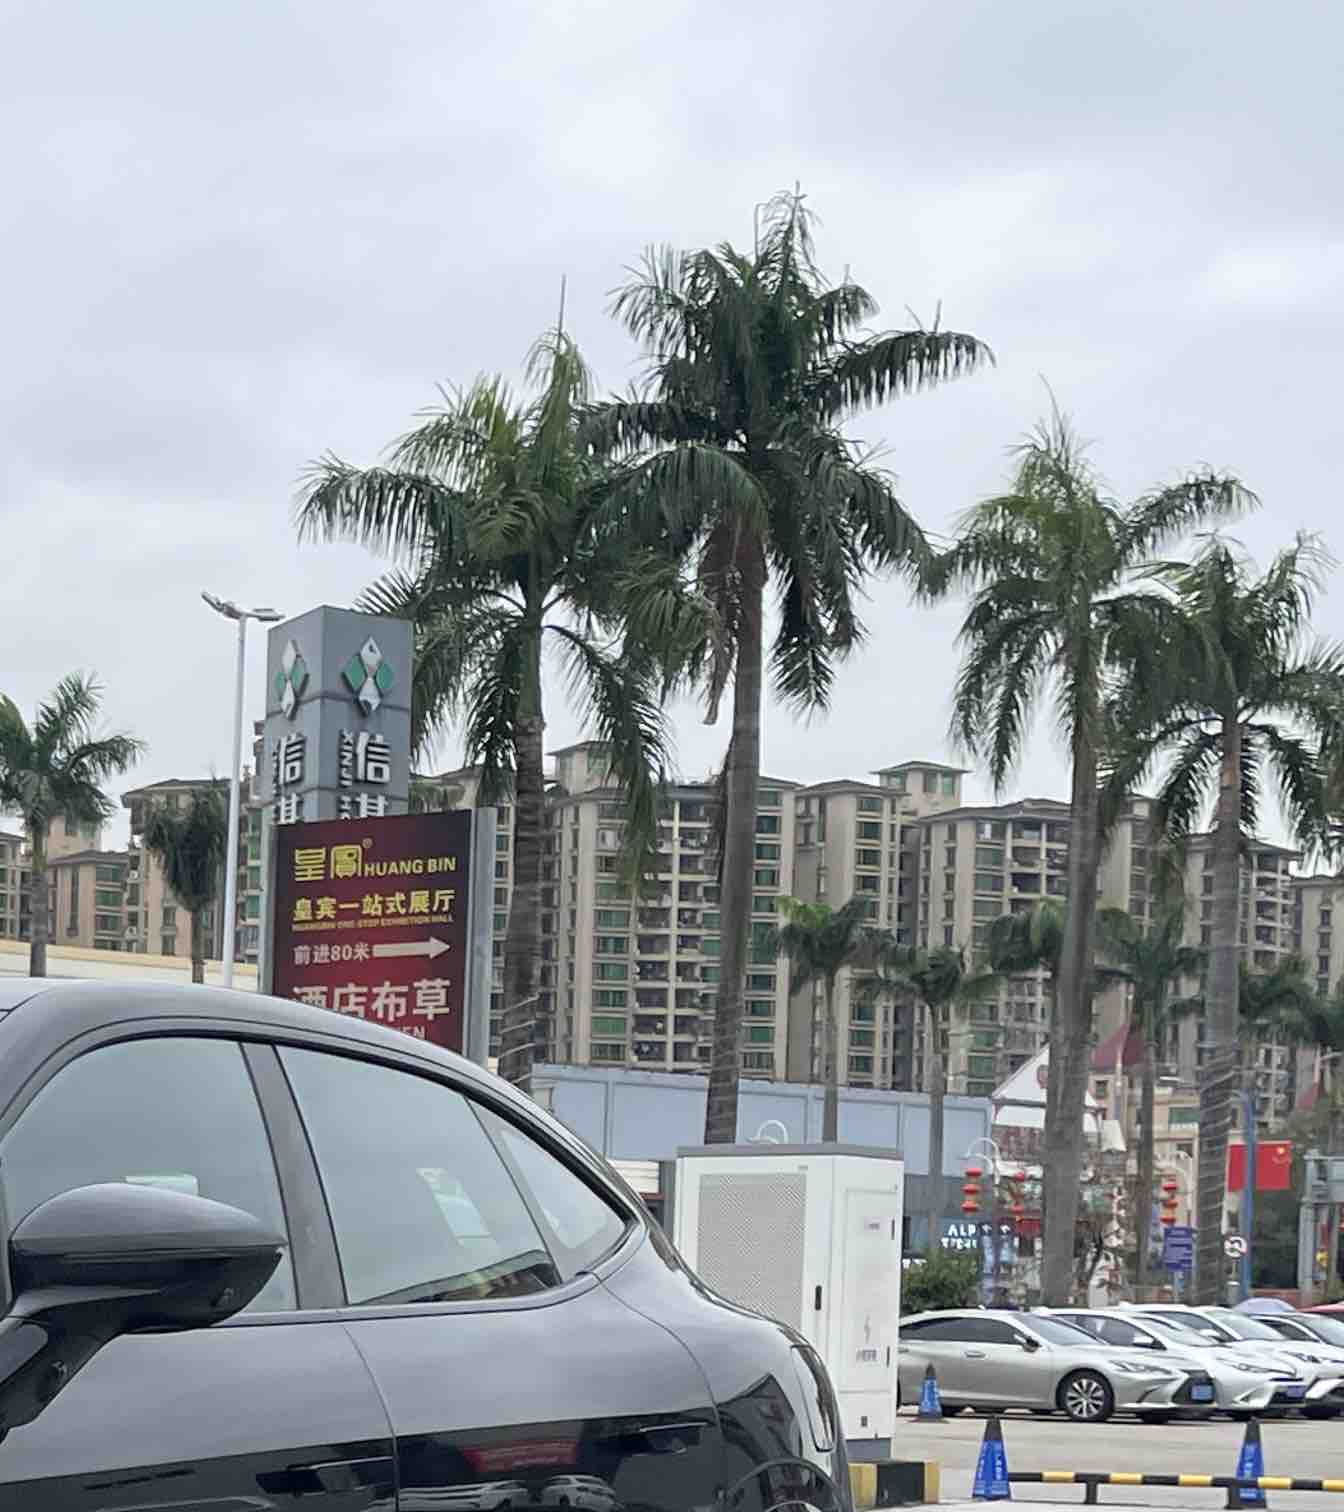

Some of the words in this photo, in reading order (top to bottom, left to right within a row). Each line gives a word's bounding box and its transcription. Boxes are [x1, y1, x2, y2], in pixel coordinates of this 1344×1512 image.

[365, 859, 423, 877] HUANG
[427, 857, 456, 874] BIN
[293, 942, 370, 966] 前进80米
